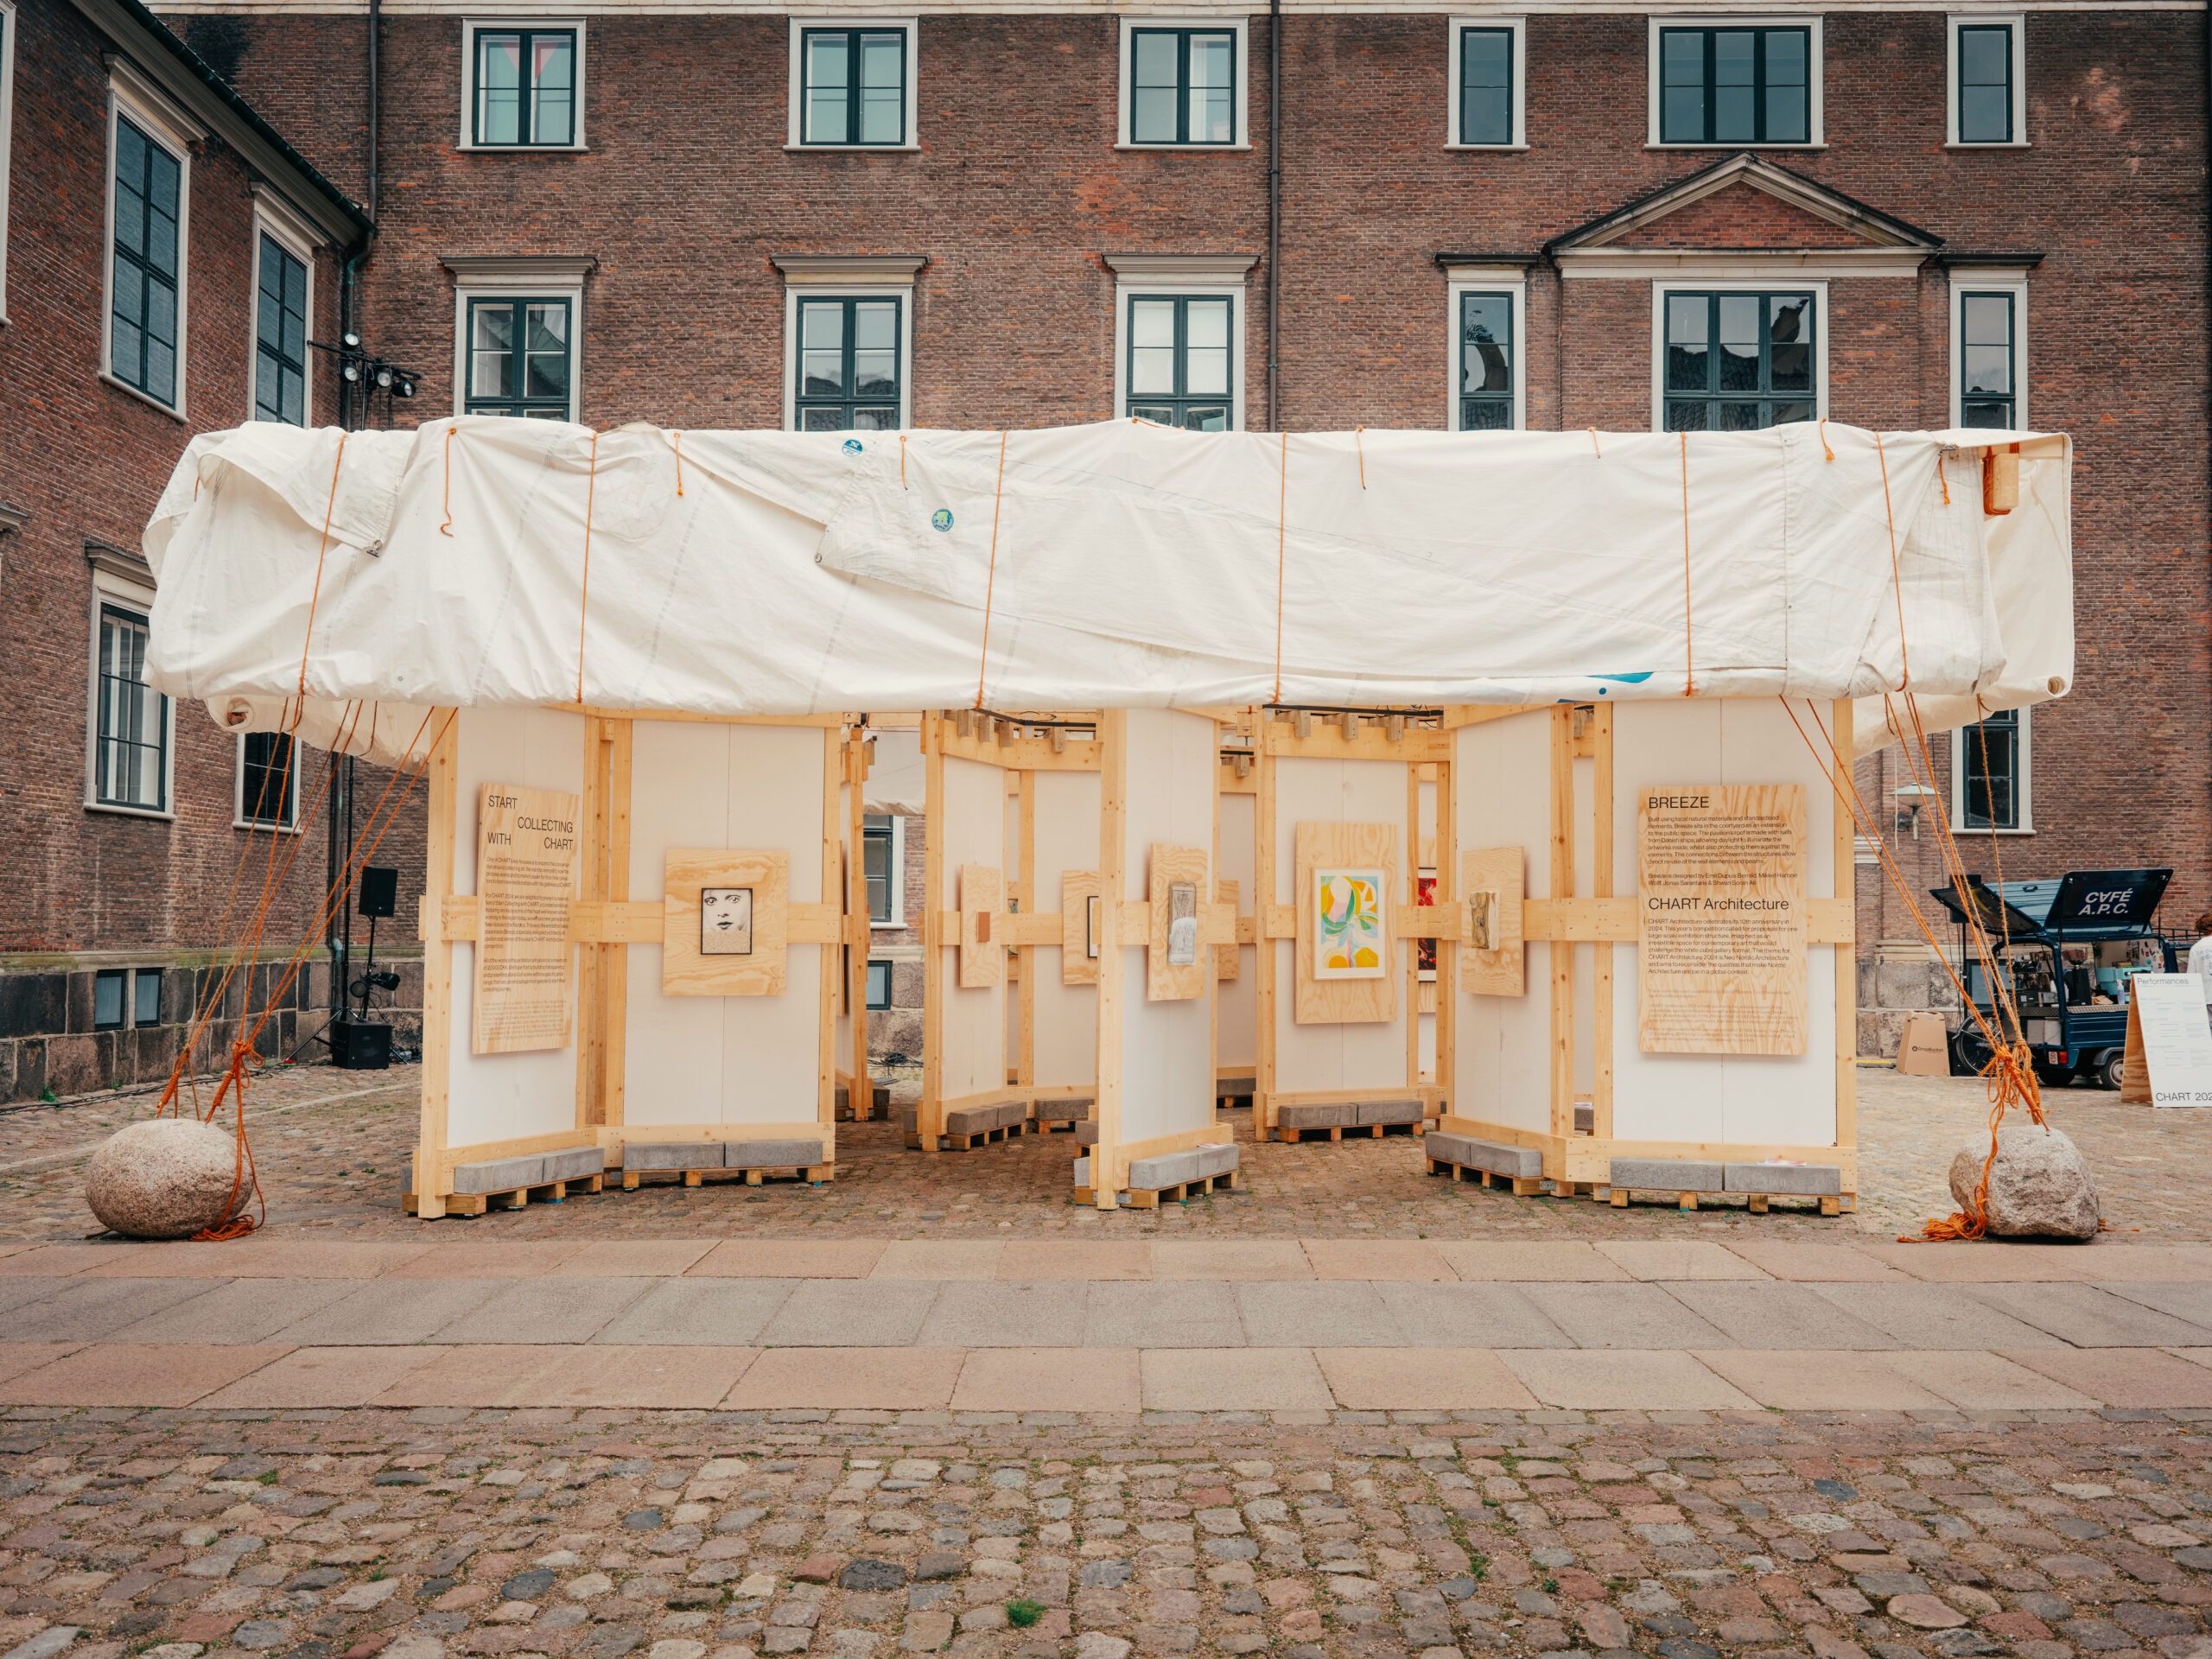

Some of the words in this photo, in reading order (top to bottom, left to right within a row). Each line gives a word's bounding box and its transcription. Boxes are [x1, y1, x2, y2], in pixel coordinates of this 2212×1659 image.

[489, 795, 518, 809] START
[1649, 797, 1709, 809] BREEZE
[518, 817, 573, 833] COLLECTING
[487, 831, 512, 845] WITH
[544, 836, 574, 850] CHART
[1649, 898, 1700, 910] CHART
[1704, 899, 1789, 910] Architecture
[2078, 904, 2128, 916] A.P.C.
[2156, 1092, 2191, 1101] CHART
